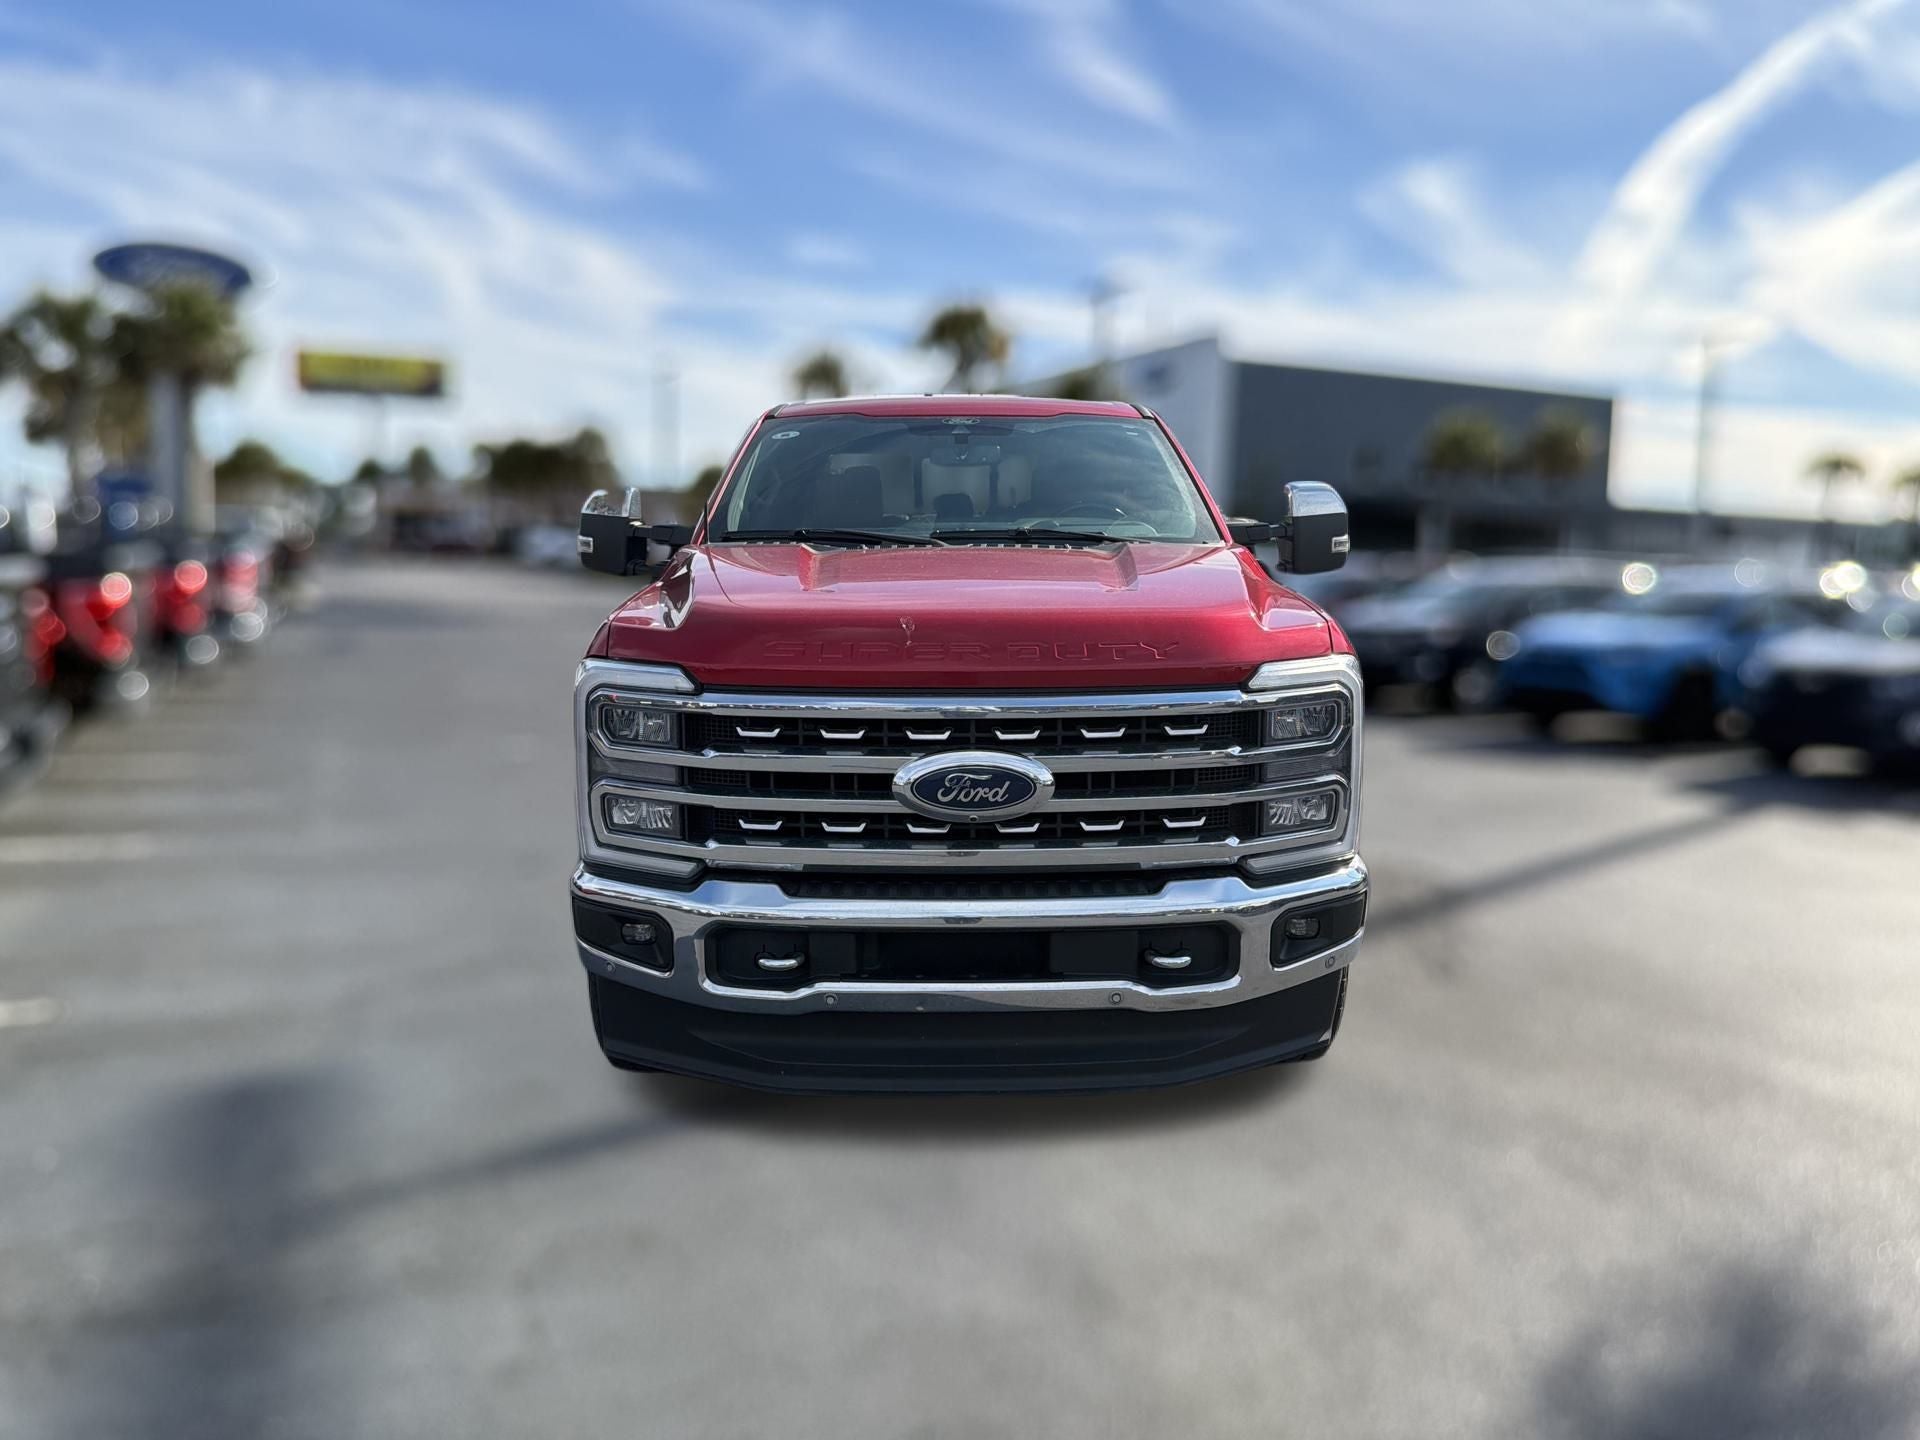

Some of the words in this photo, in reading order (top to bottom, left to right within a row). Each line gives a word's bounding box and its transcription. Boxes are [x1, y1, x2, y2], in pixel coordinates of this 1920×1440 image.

[763, 641, 991, 661] SUPER
[1007, 641, 1180, 661] DUTY
[937, 773, 1011, 803] Ford
